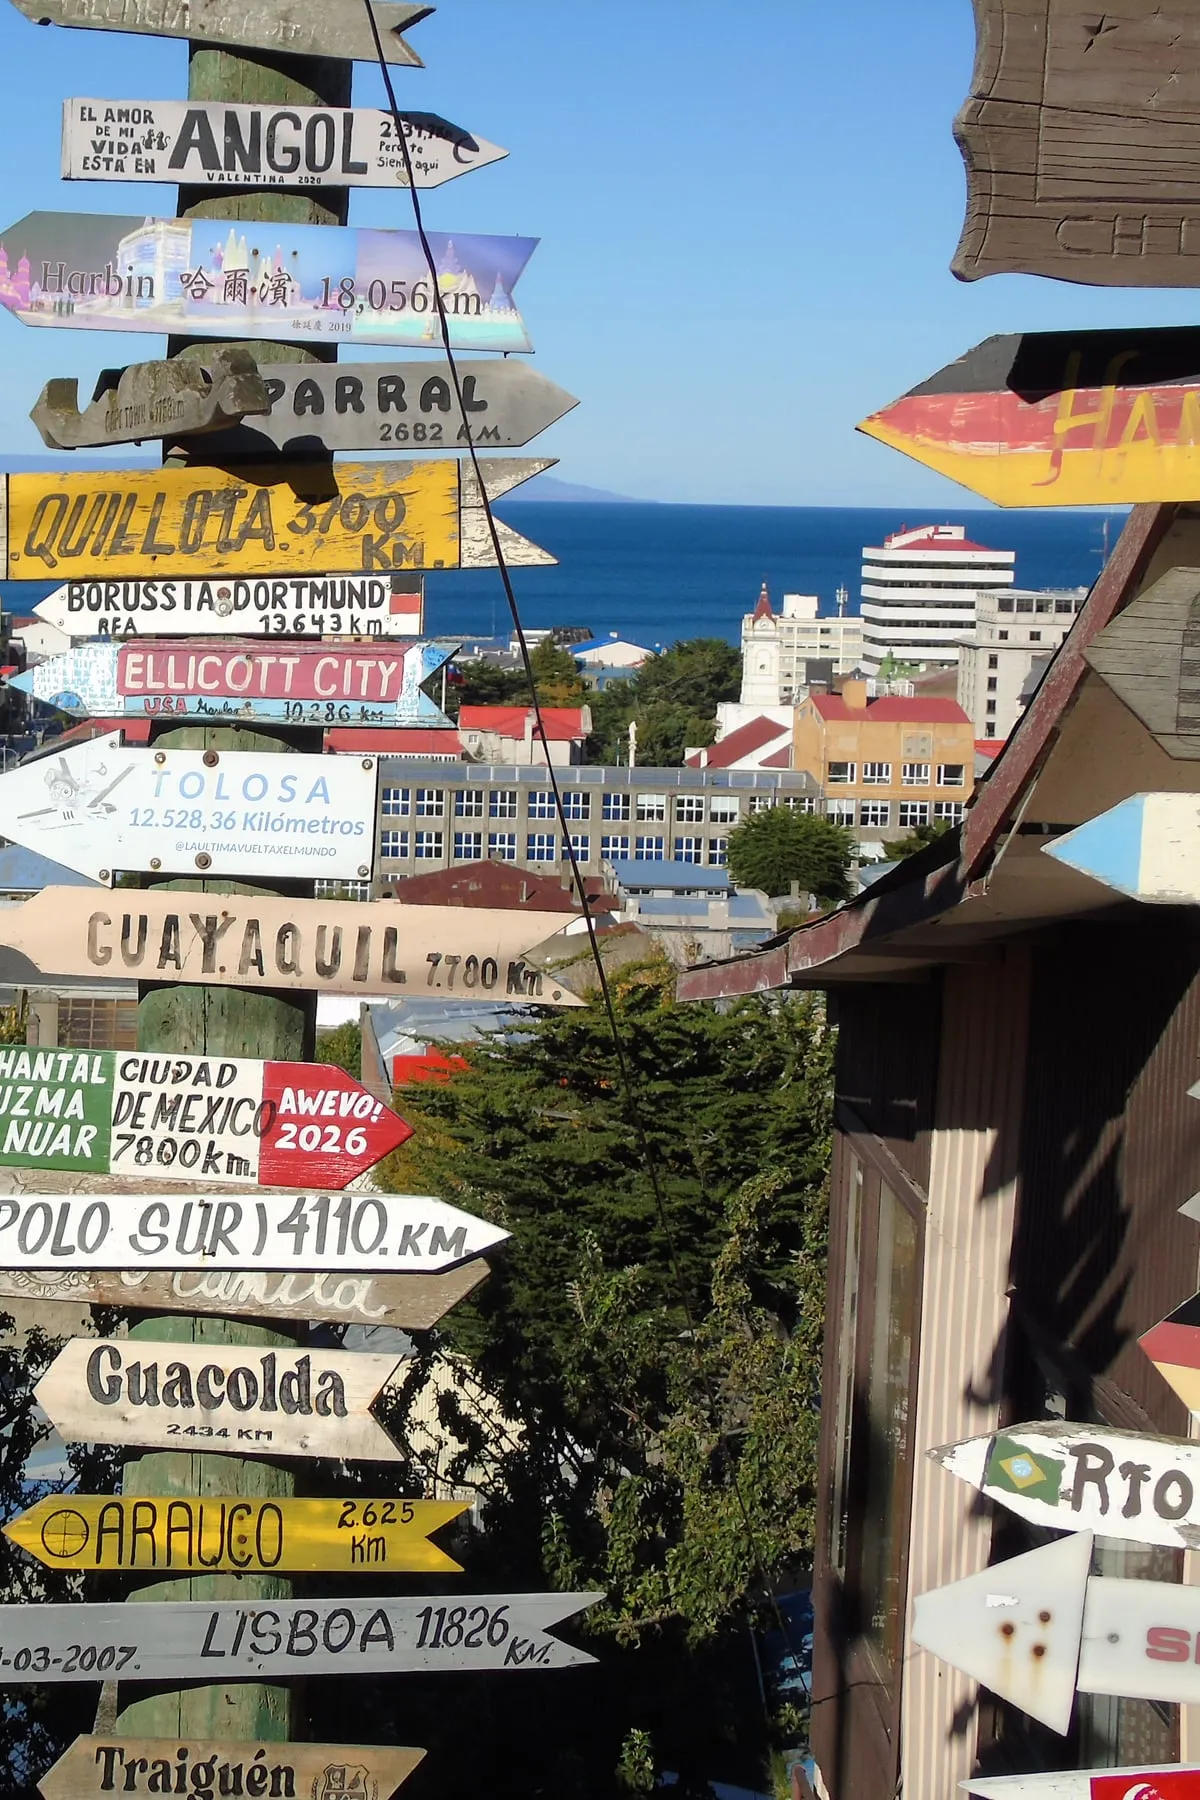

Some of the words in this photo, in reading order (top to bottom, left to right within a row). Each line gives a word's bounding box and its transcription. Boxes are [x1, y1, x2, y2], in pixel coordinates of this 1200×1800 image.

[80, 106, 97, 122] EL
[104, 108, 154, 125] AMOR
[91, 140, 142, 155] VIDA
[96, 126, 110, 137] DE
[119, 127, 134, 138] MI
[168, 109, 368, 175] ANGOL
[82, 155, 128, 173] ESTÁ
[135, 158, 155, 174] EN
[409, 143, 423, 154] te
[207, 172, 285, 184] VALENTINA
[298, 176, 322, 185] 2020
[41, 262, 155, 298] Harbin
[180, 265, 293, 307] 哈爾濱
[328, 322, 352, 332] 2019
[264, 375, 488, 416] PARRAL
[379, 422, 443, 442] 2682
[67, 581, 214, 612] BORUSSIA
[233, 579, 386, 611] DORTMUND
[98, 617, 138, 634] RFA
[124, 652, 300, 695] ELLICOTT
[313, 656, 398, 697] CITY
[144, 696, 188, 715] USA
[151, 769, 331, 805] TOLOSA
[129, 807, 237, 833] 12.528,36
[241, 811, 366, 836] Kilómetros
[175, 841, 338, 858] @LAULTIMAVUELTAXELMUNDO
[87, 911, 406, 984] GUAYAQUIL
[119, 1057, 238, 1089] CIUDAD
[279, 1086, 384, 1124] AWEVO!
[274, 1122, 368, 1157] 2026
[86, 1344, 349, 1417] Guacolda
[166, 1423, 231, 1439] 2434
[237, 1428, 274, 1442] KM
[1069, 1442, 1194, 1520] RIO
[337, 1500, 415, 1529] 2.625
[95, 1501, 283, 1567] ARAUCO
[200, 1607, 395, 1658] LISBOA
[95, 1746, 297, 1800] Traiguén
